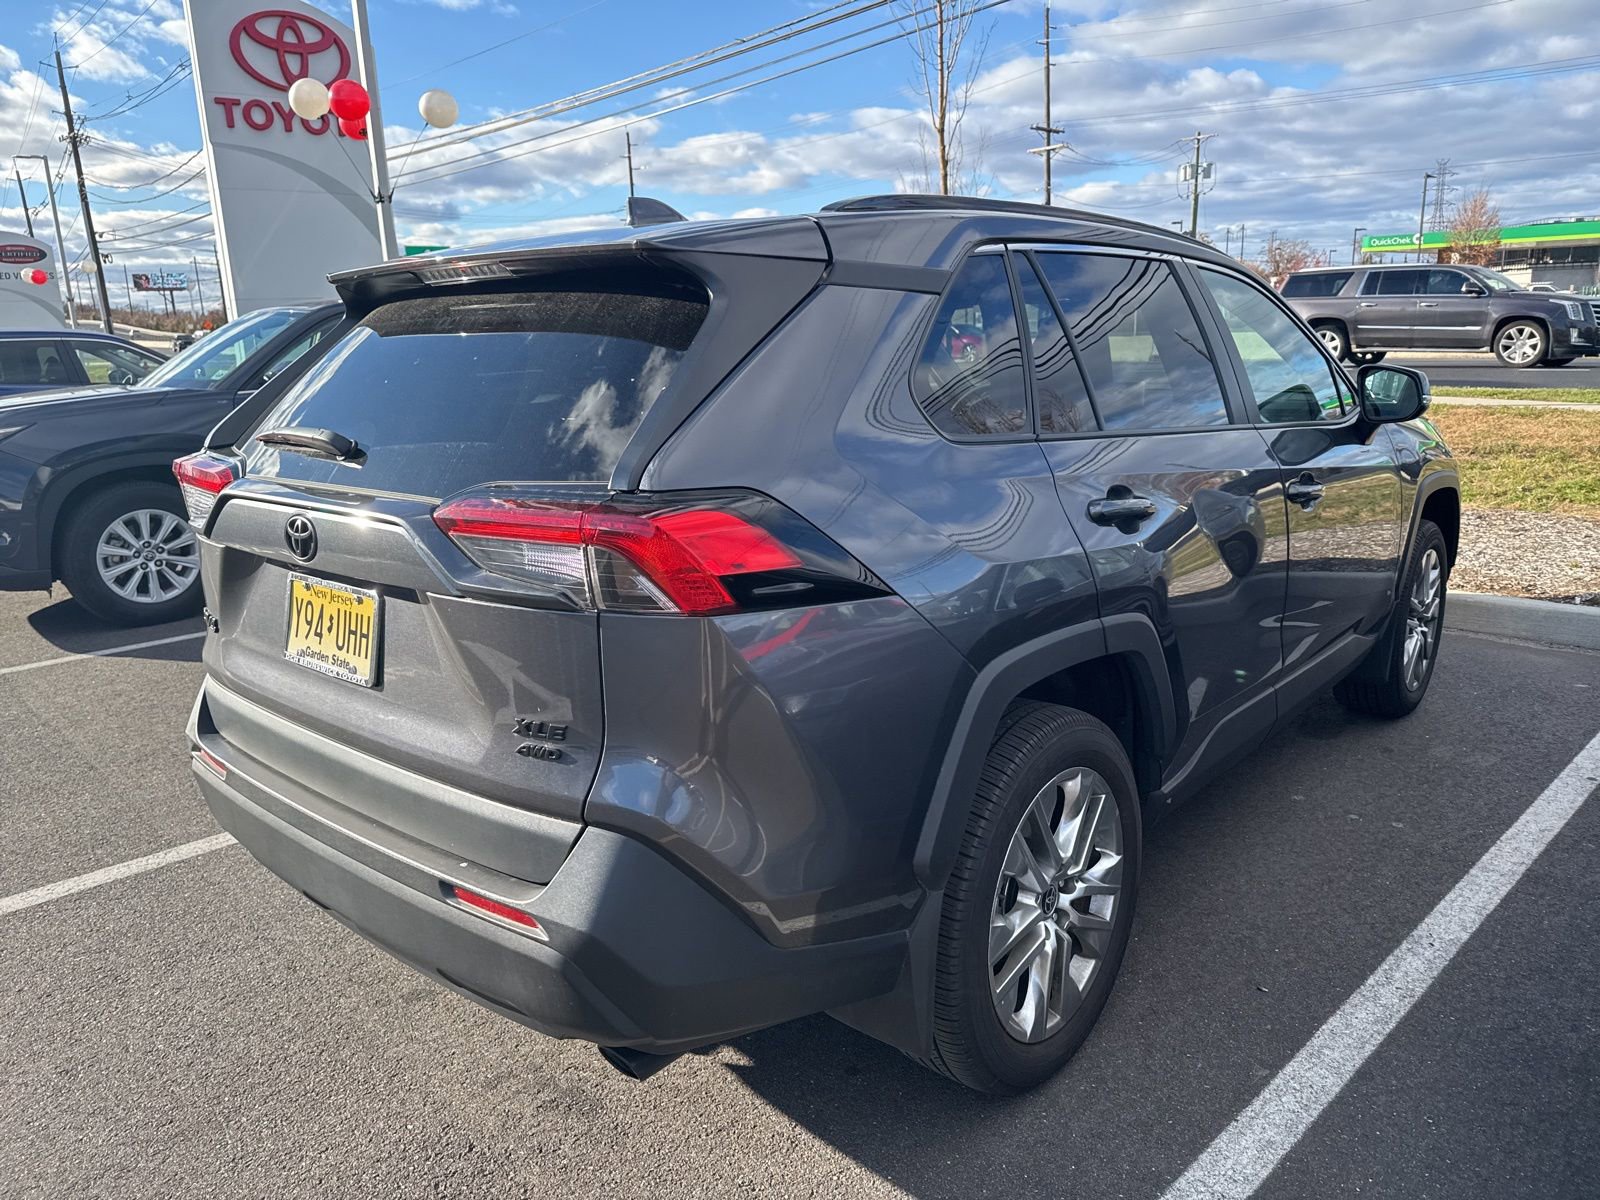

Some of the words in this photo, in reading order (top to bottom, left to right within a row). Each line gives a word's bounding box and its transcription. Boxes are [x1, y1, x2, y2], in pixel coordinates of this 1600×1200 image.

[214, 97, 346, 137] TOYO
[1370, 236, 1411, 246] QuickChek
[310, 583, 328, 599] New
[328, 589, 354, 609] Jersey
[305, 646, 329, 663] Garden
[331, 654, 350, 670] State
[338, 670, 367, 685] TOYOTA
[512, 718, 568, 741] XLE
[514, 742, 562, 760] AWD
